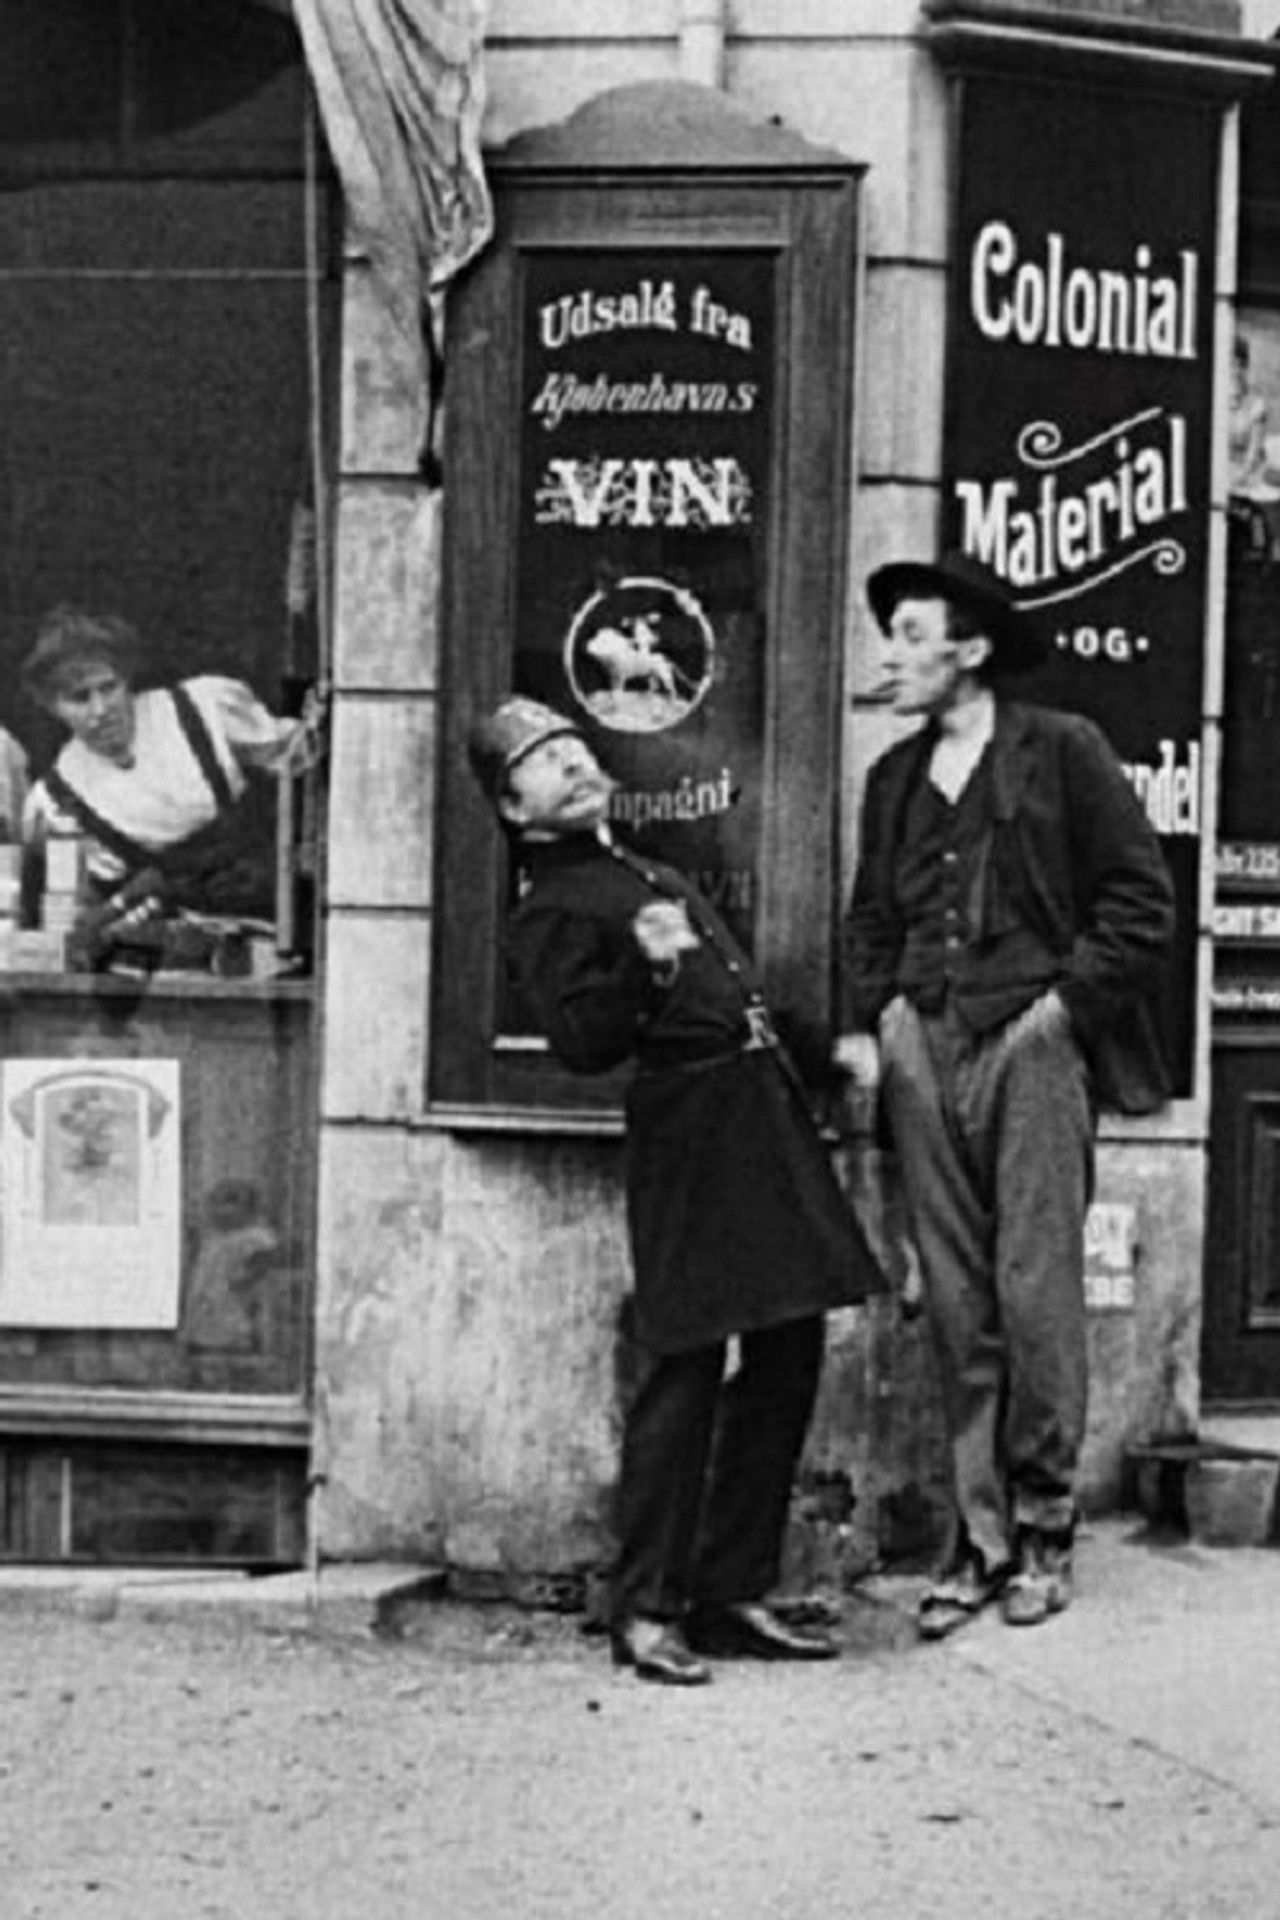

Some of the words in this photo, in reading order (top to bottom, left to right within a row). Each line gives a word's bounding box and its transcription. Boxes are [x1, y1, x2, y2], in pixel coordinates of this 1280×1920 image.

[541, 280, 676, 347] Udsalg
[691, 284, 752, 349] fra
[971, 220, 1197, 360] Colonial
[548, 457, 740, 527] VIN
[955, 413, 1186, 586] Material
